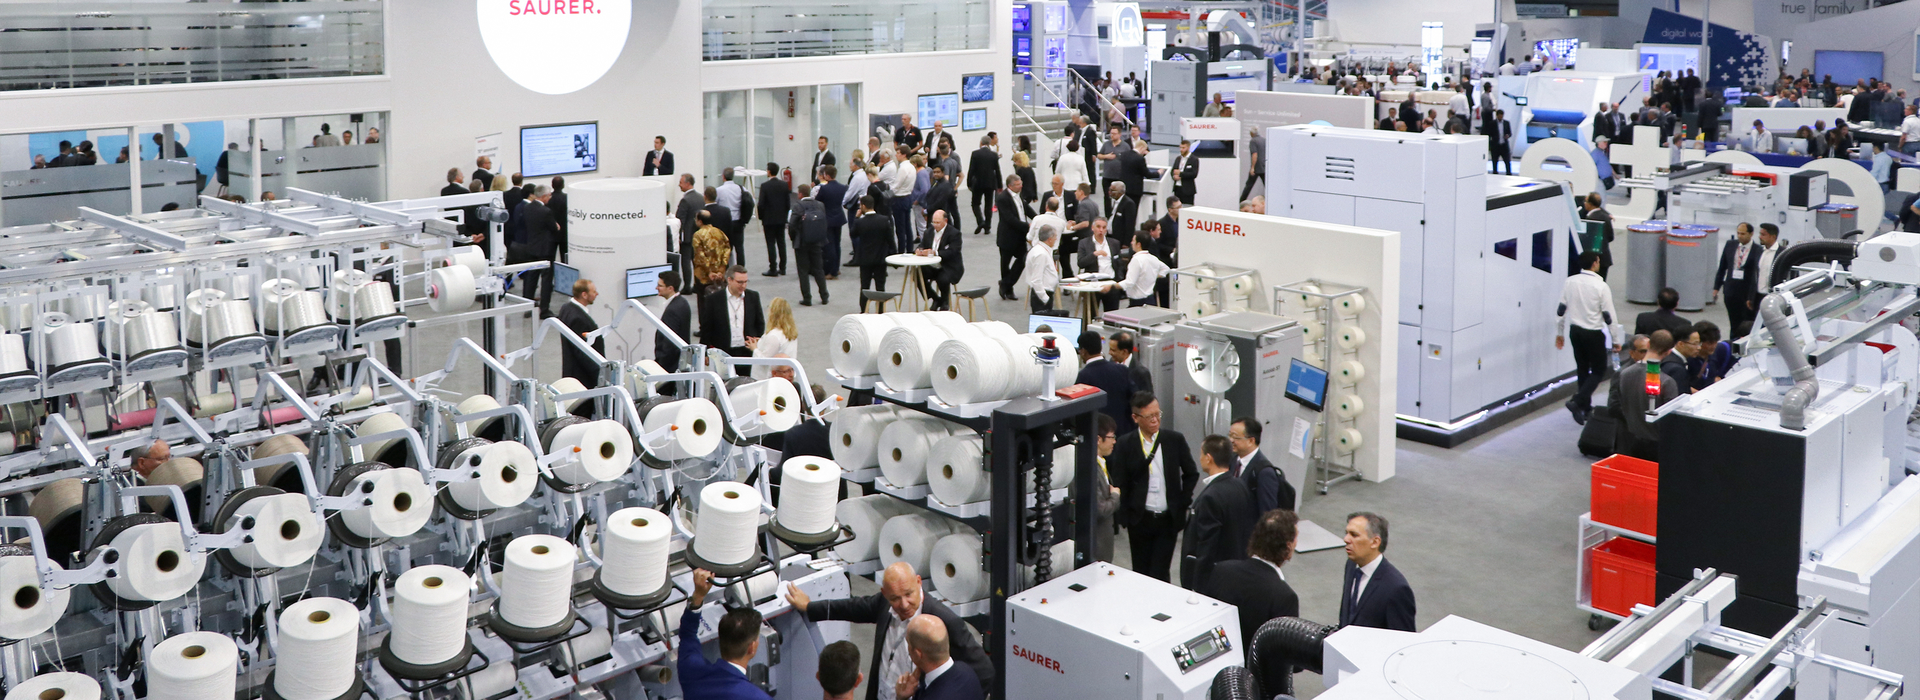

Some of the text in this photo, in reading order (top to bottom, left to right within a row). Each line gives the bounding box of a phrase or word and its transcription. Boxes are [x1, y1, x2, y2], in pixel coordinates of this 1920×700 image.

[509, 0, 601, 15] SAURER.
[1781, 2, 1805, 14] true
[1661, 27, 1714, 40] digital wod
[590, 209, 647, 220] connected.
[1187, 218, 1246, 236] SAURER.
[1012, 644, 1065, 675] SAURER.
